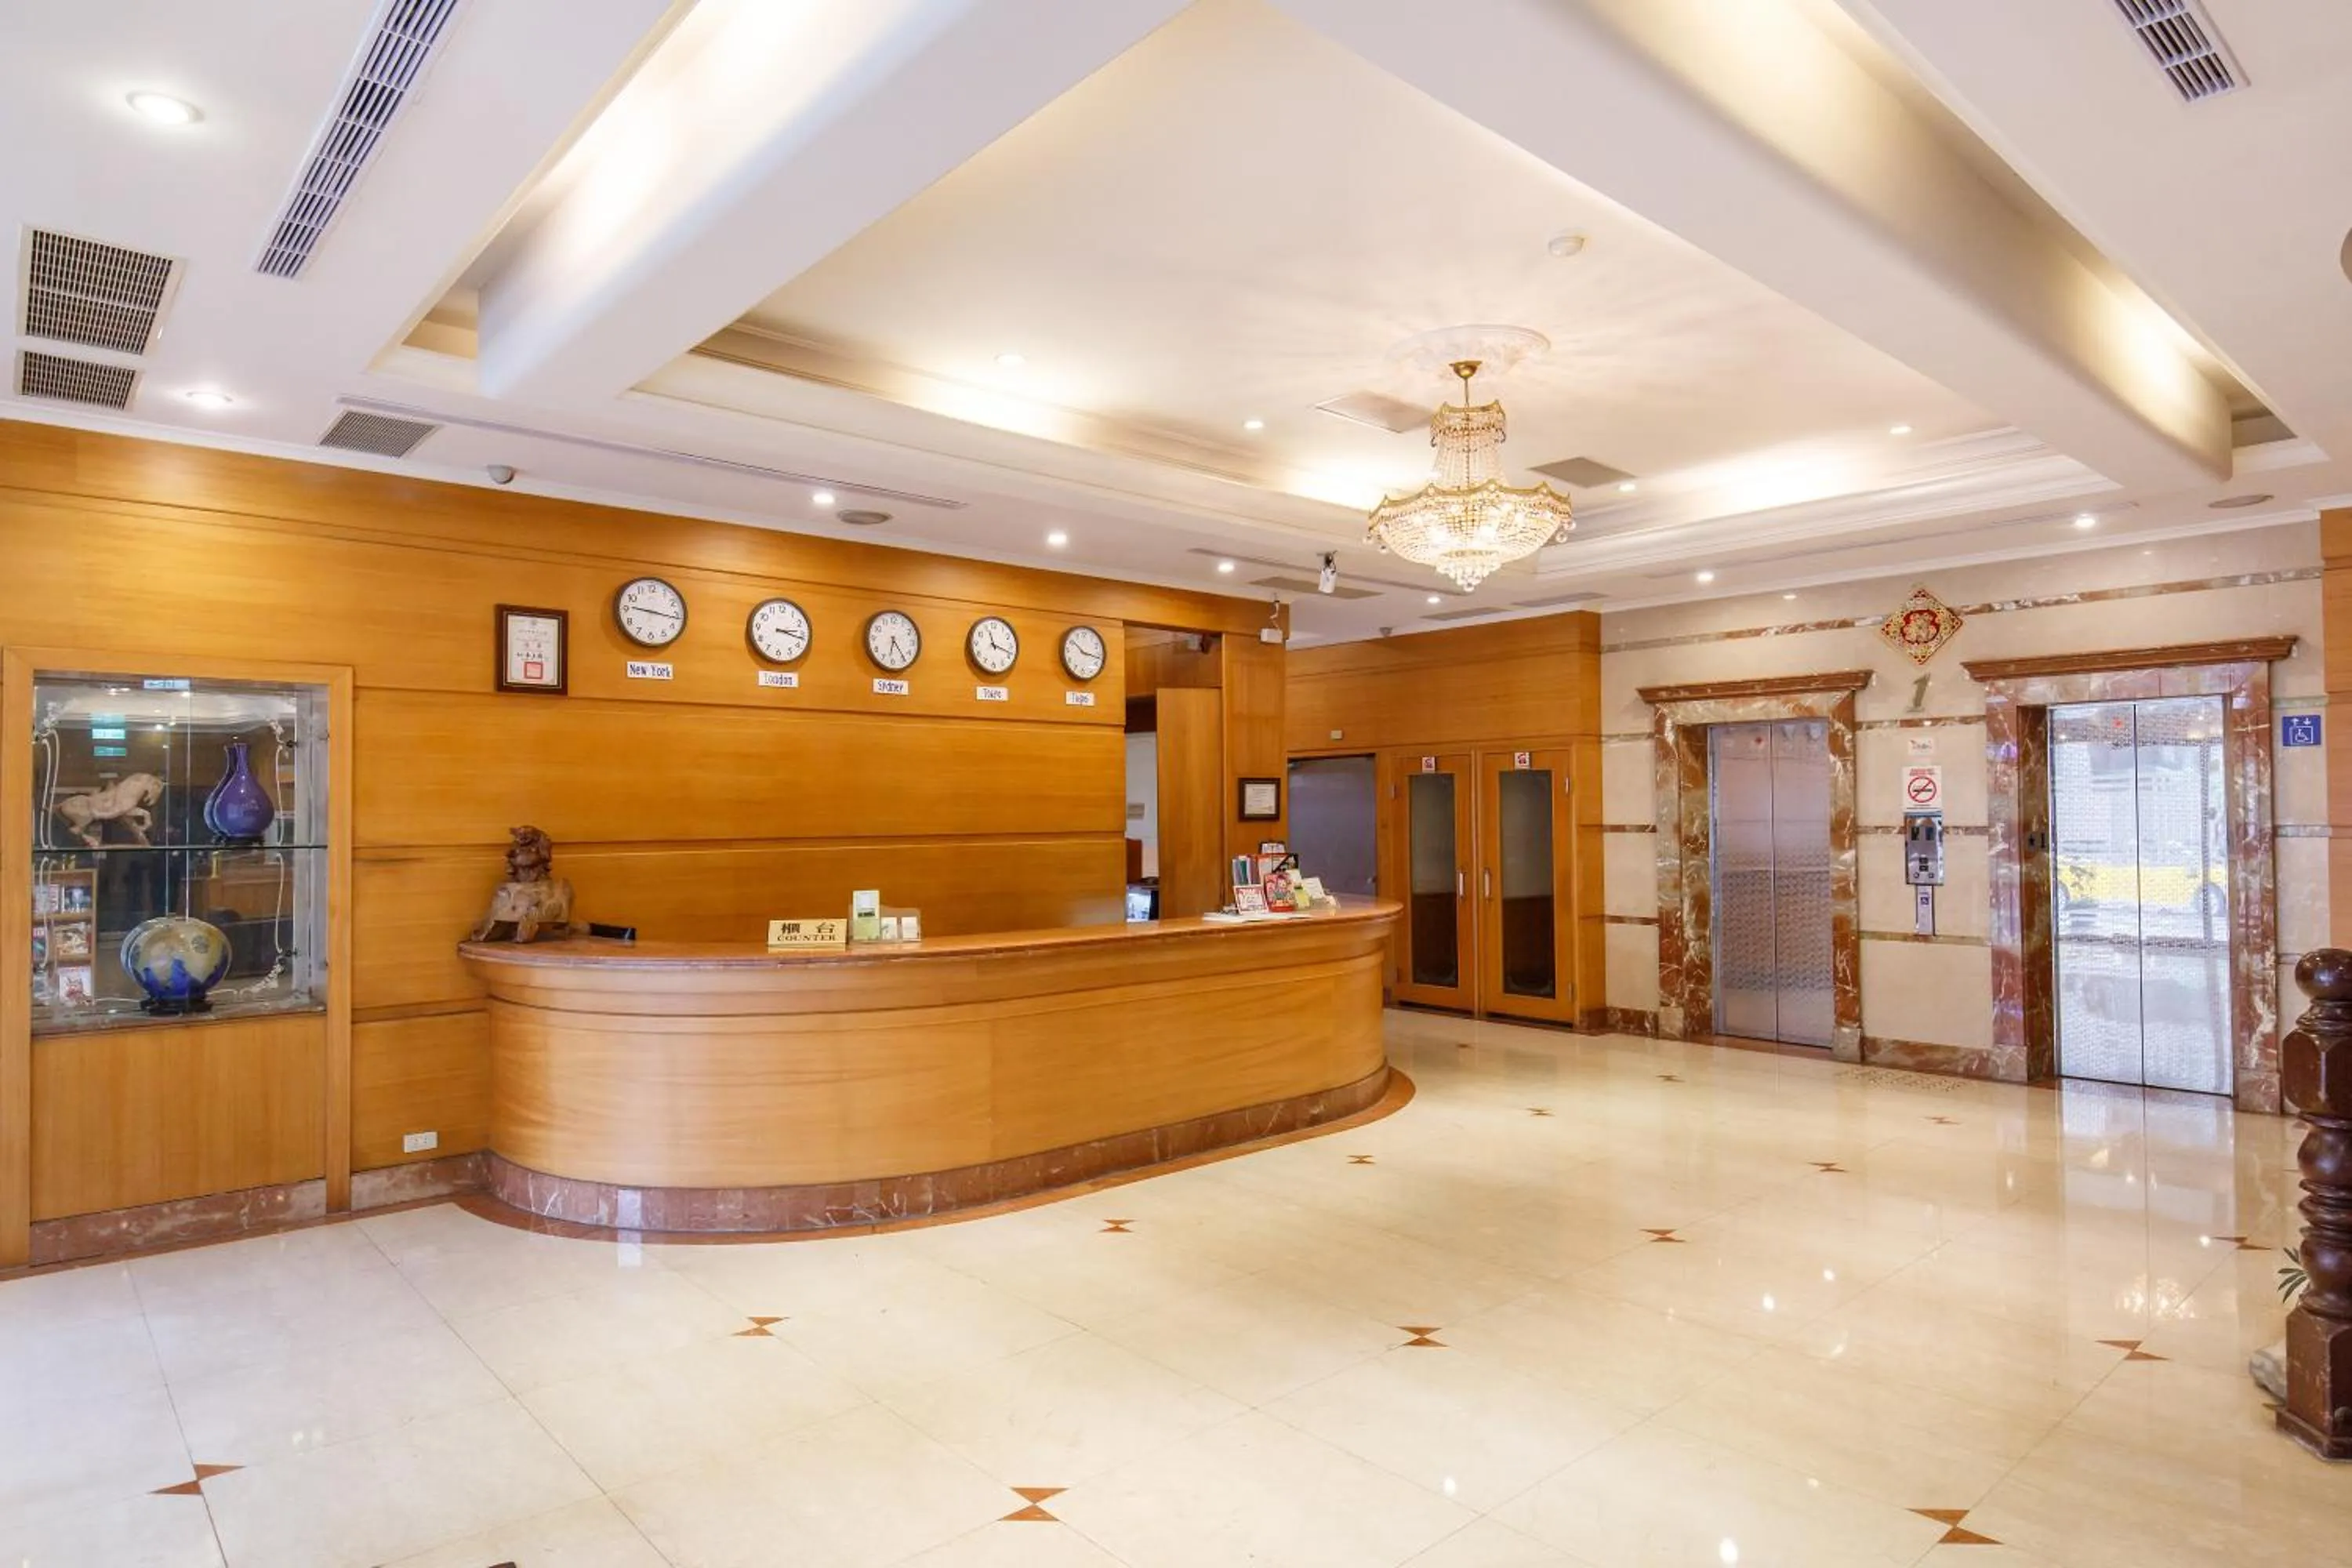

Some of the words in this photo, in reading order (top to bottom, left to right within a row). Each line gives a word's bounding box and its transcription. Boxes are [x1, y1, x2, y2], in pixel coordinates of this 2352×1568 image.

[637, 586, 644, 594] 11
[646, 584, 656, 593] 12
[628, 593, 637, 603] 10
[778, 604, 786, 613] 12
[626, 617, 633, 626] 8
[760, 612, 769, 622] 10
[636, 626, 643, 635] 7
[755, 622, 761, 631] 9
[648, 631, 655, 641] 6
[630, 664, 647, 676] New
[651, 665, 671, 677] York
[1906, 673, 1931, 712] 1
